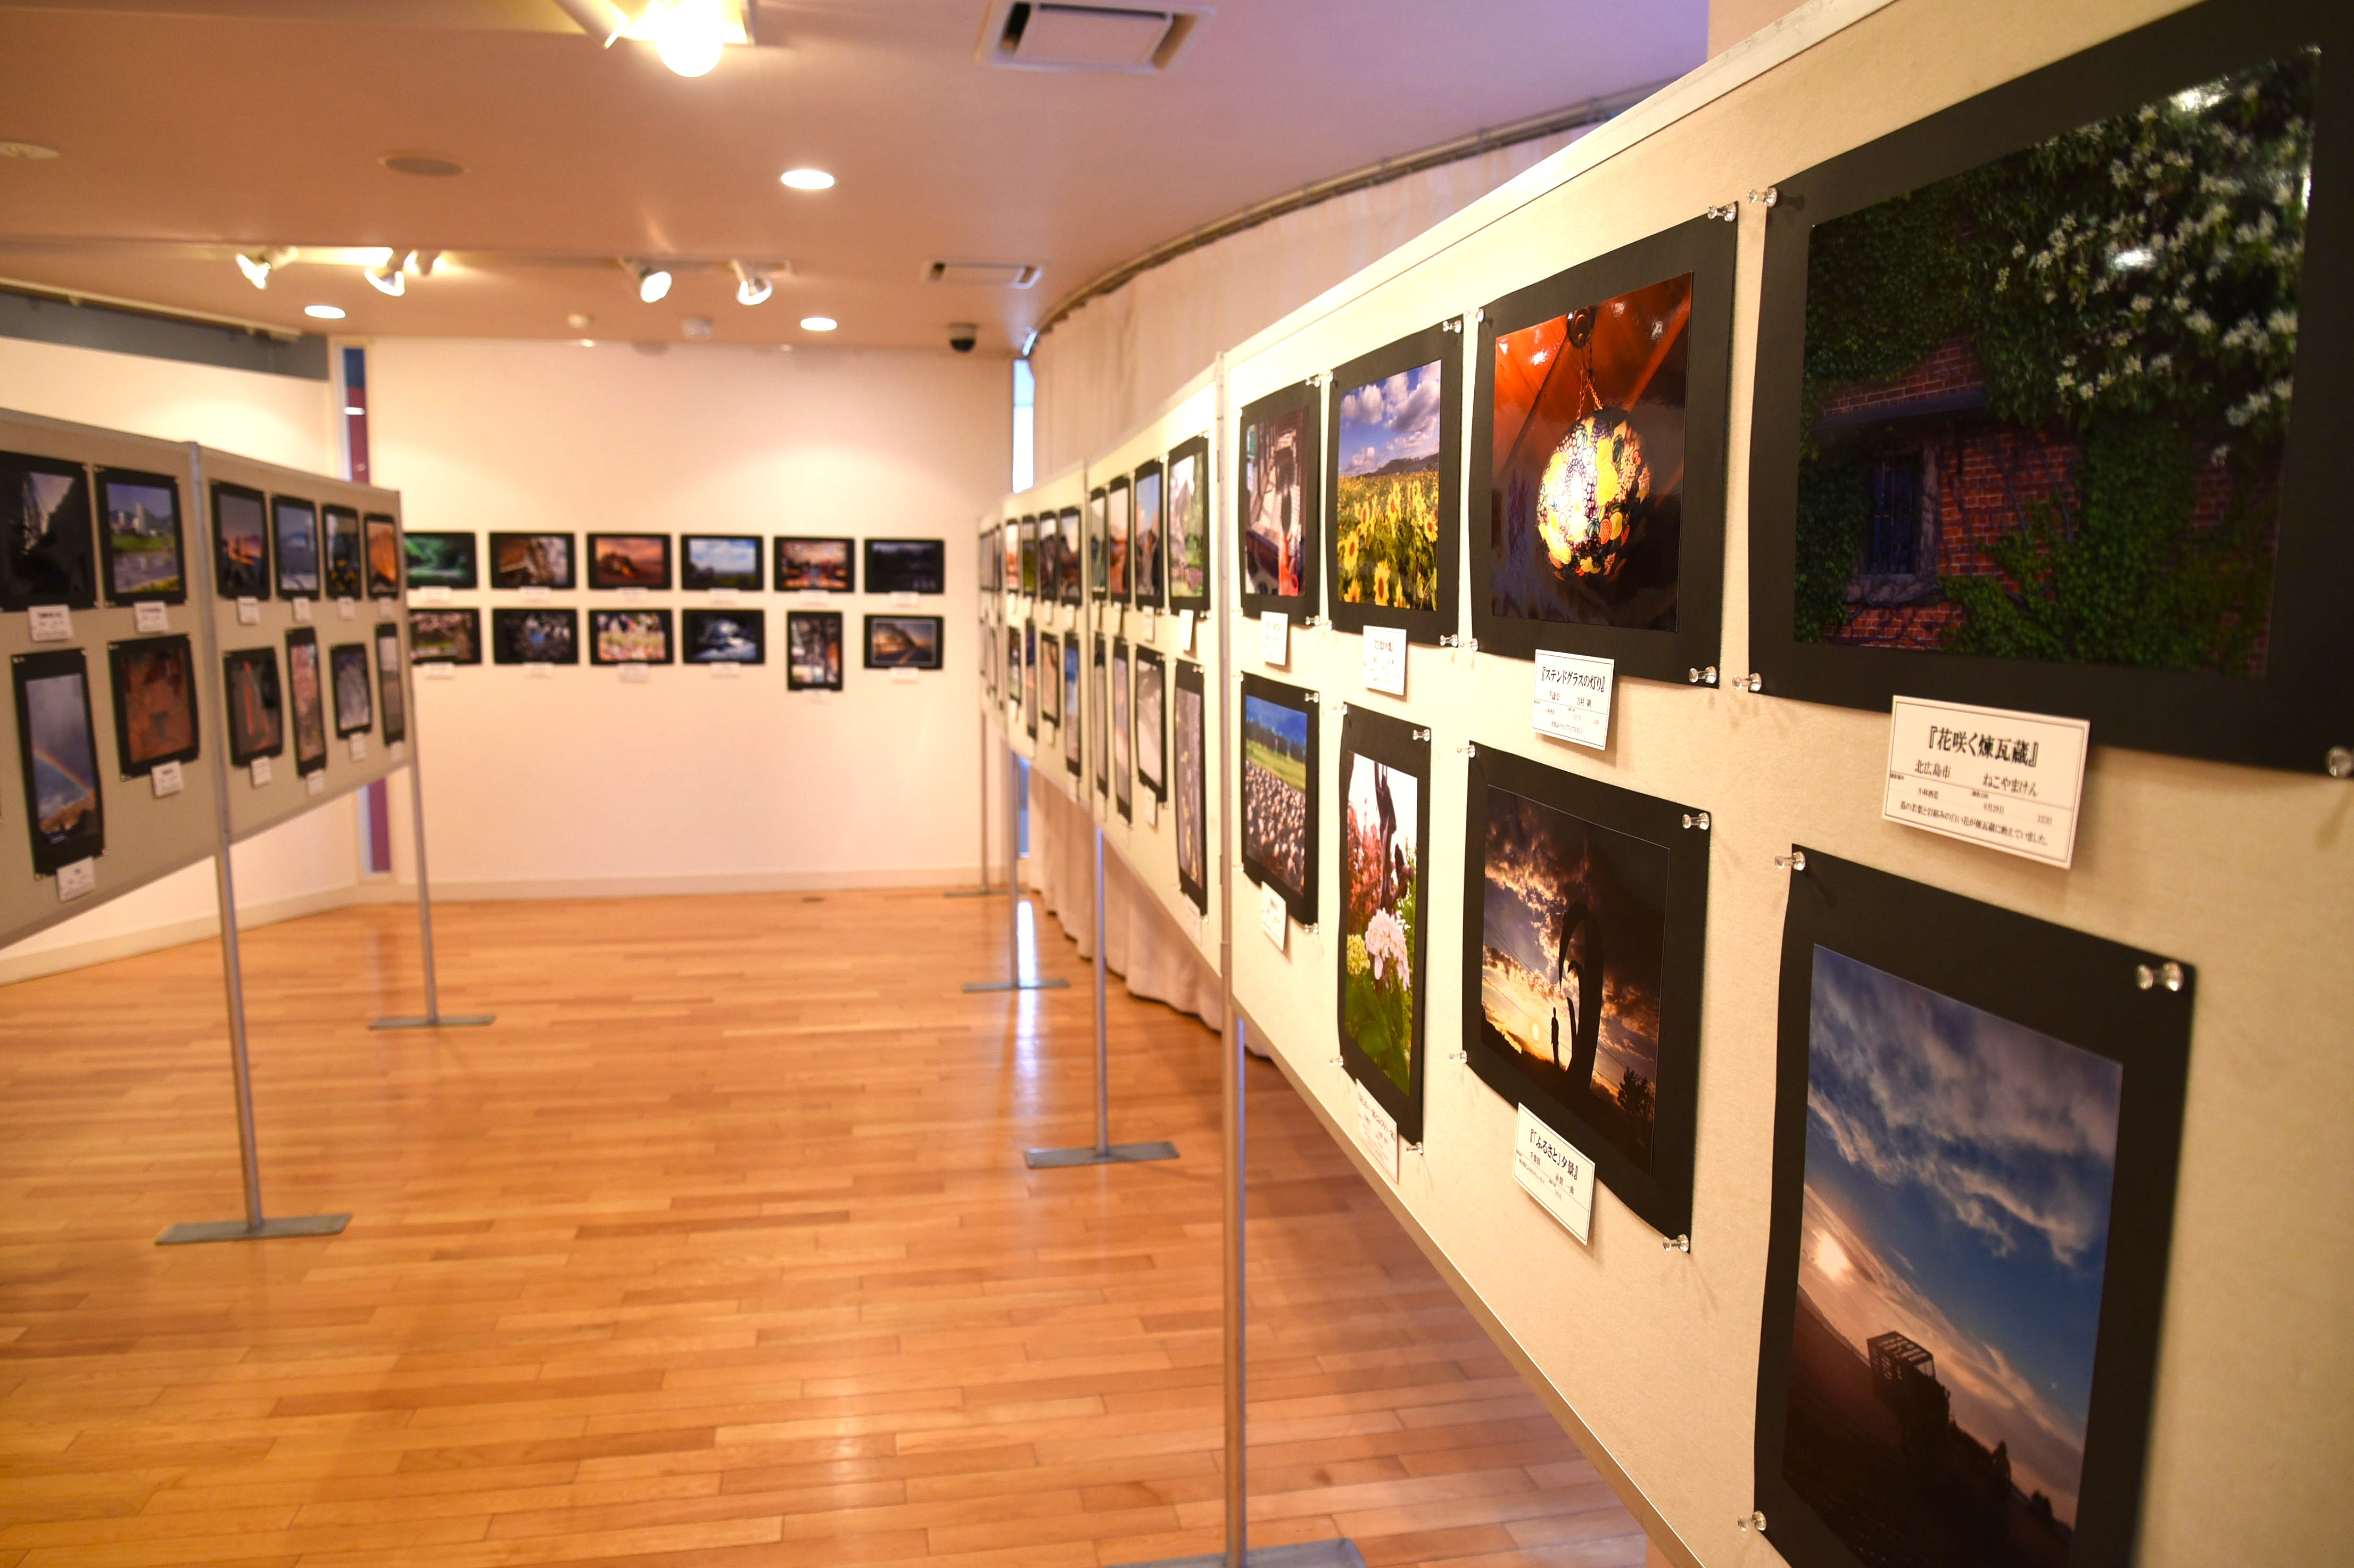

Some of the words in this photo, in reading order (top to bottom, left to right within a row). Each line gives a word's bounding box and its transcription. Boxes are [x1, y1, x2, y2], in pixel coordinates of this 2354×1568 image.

[1542, 666, 1605, 692] 『ステンドグラスの灯り』
[1929, 725, 2039, 768] 『花咲く煉瓦蔵』
[1915, 758, 1951, 779] 北広島市
[1983, 772, 2038, 797] ねこやまけん
